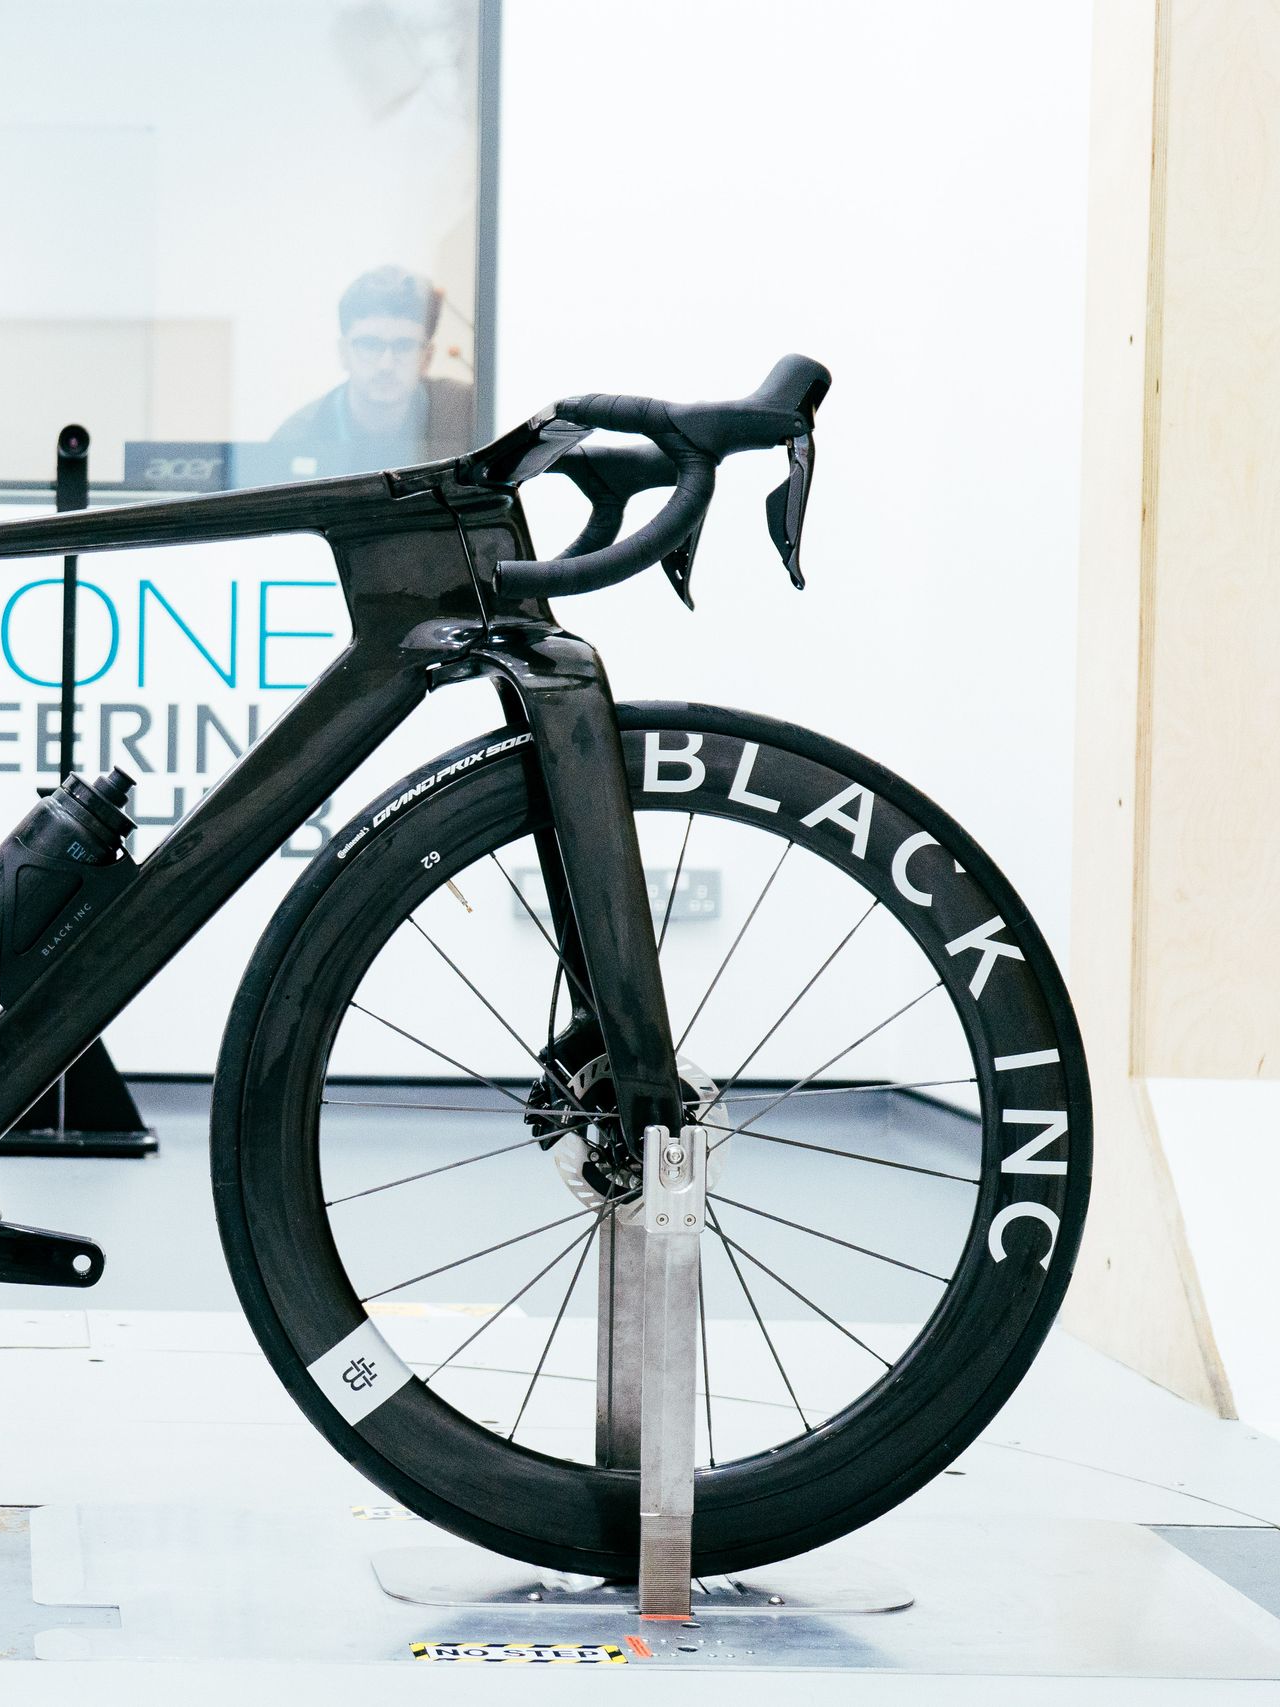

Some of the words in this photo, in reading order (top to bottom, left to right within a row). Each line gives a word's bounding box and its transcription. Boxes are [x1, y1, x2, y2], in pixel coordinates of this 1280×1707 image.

[144, 458, 222, 481] acer
[372, 775, 435, 829] GRAND
[435, 749, 485, 783] PRIX
[485, 732, 535, 758] 500
[420, 850, 441, 870] 62
[41, 922, 73, 956] BLACK
[73, 903, 92, 922] INC
[643, 732, 1026, 1000] BLACK
[987, 1047, 1068, 1272] INC
[435, 1648, 489, 1657] NO
[503, 1649, 599, 1658] STEP
